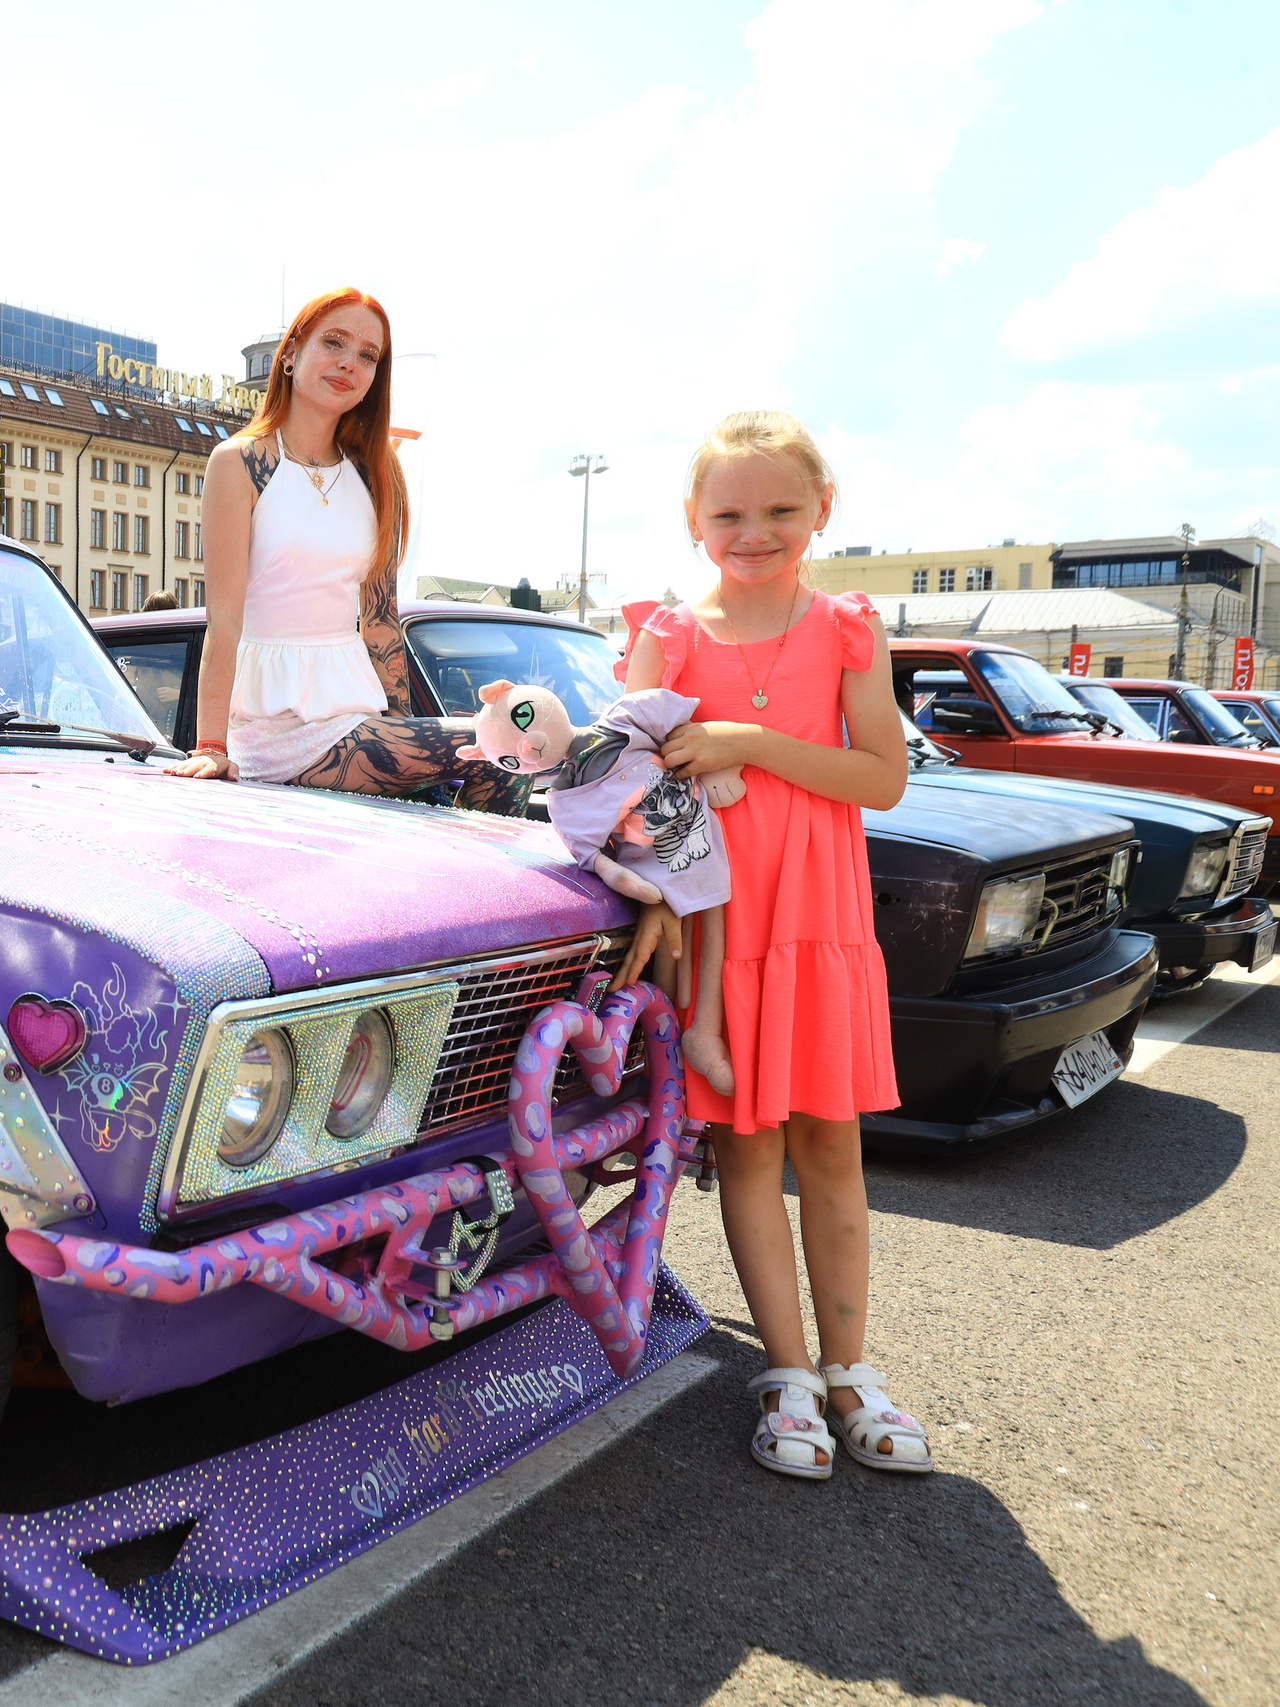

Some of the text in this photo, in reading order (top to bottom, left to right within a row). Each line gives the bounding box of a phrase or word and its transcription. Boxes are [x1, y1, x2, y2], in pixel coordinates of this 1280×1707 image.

[95, 341, 267, 415] Гостиный Дво
[101, 1078, 110, 1093] 8
[371, 1368, 560, 1501] no hard feelings
